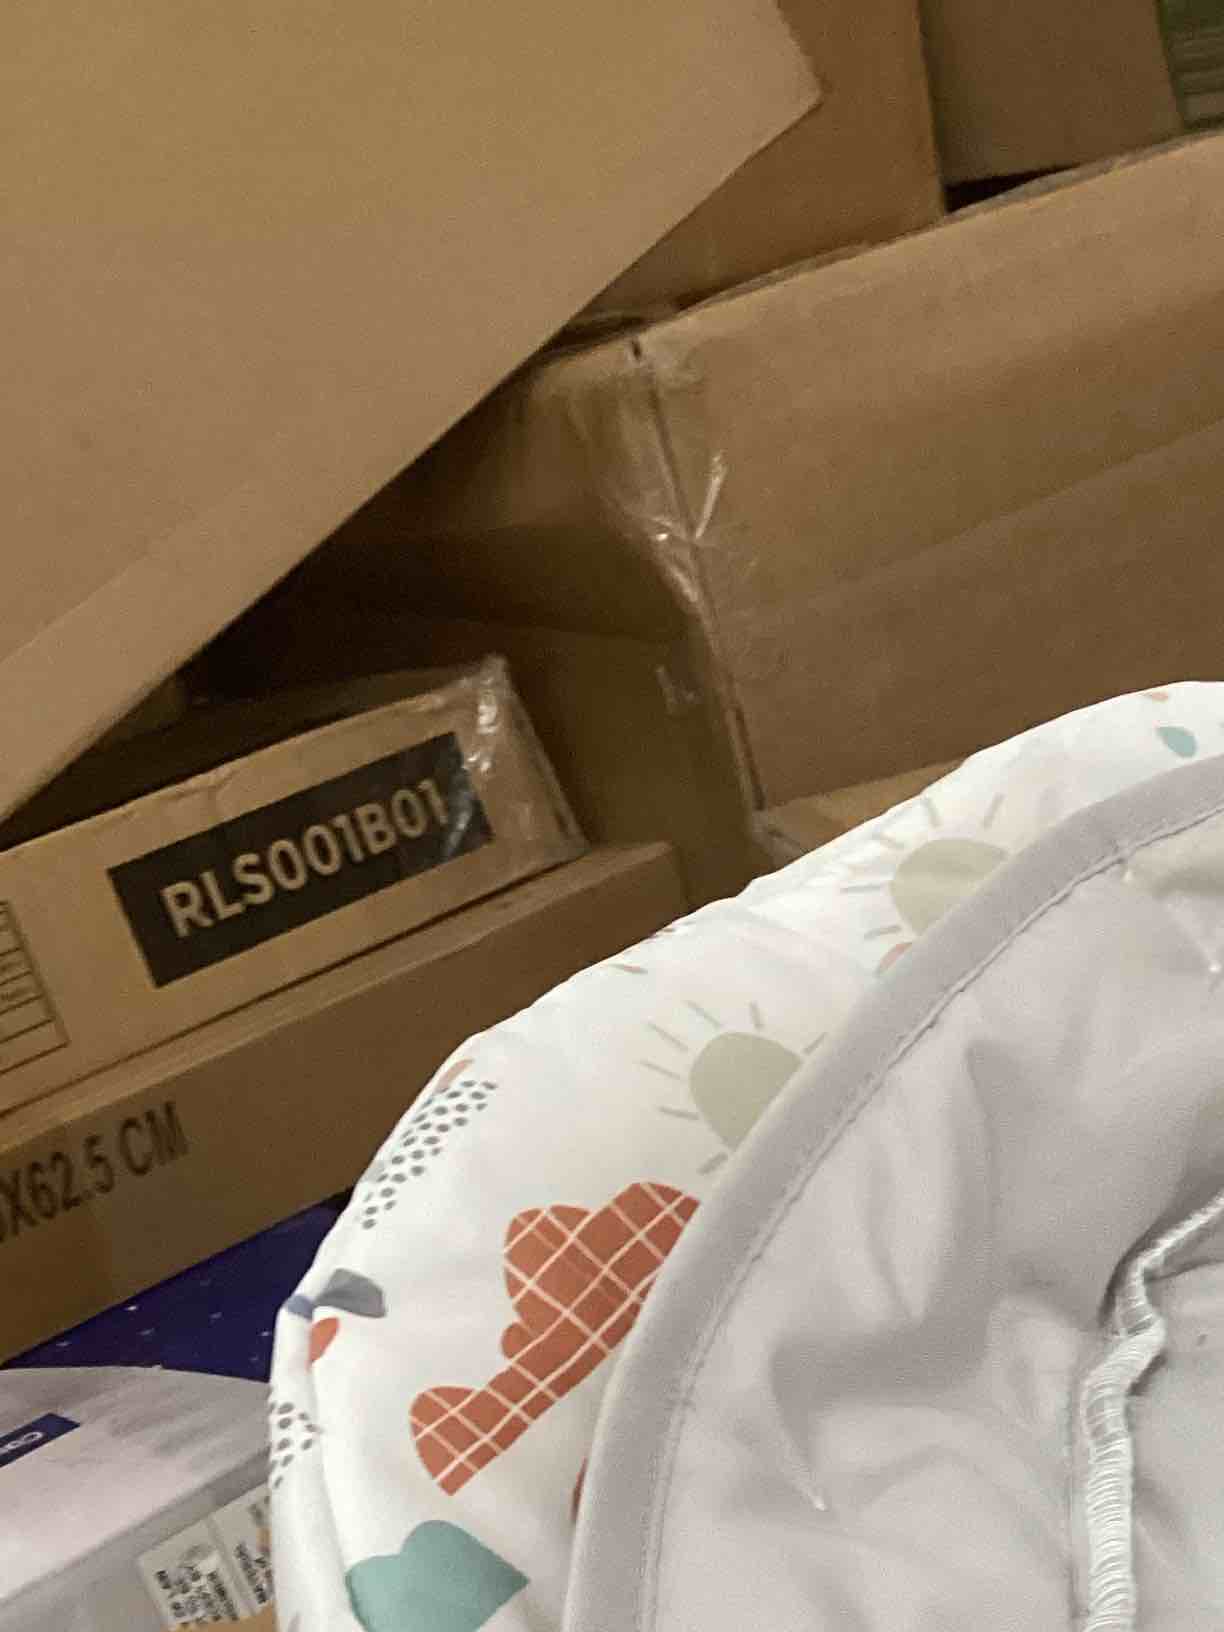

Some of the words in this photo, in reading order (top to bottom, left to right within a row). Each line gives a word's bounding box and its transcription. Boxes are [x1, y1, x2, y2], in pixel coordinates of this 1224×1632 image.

[158, 778, 450, 939] RLS001B01
[0, 1134, 116, 1243] X62.5
[118, 1100, 192, 1177] CM
